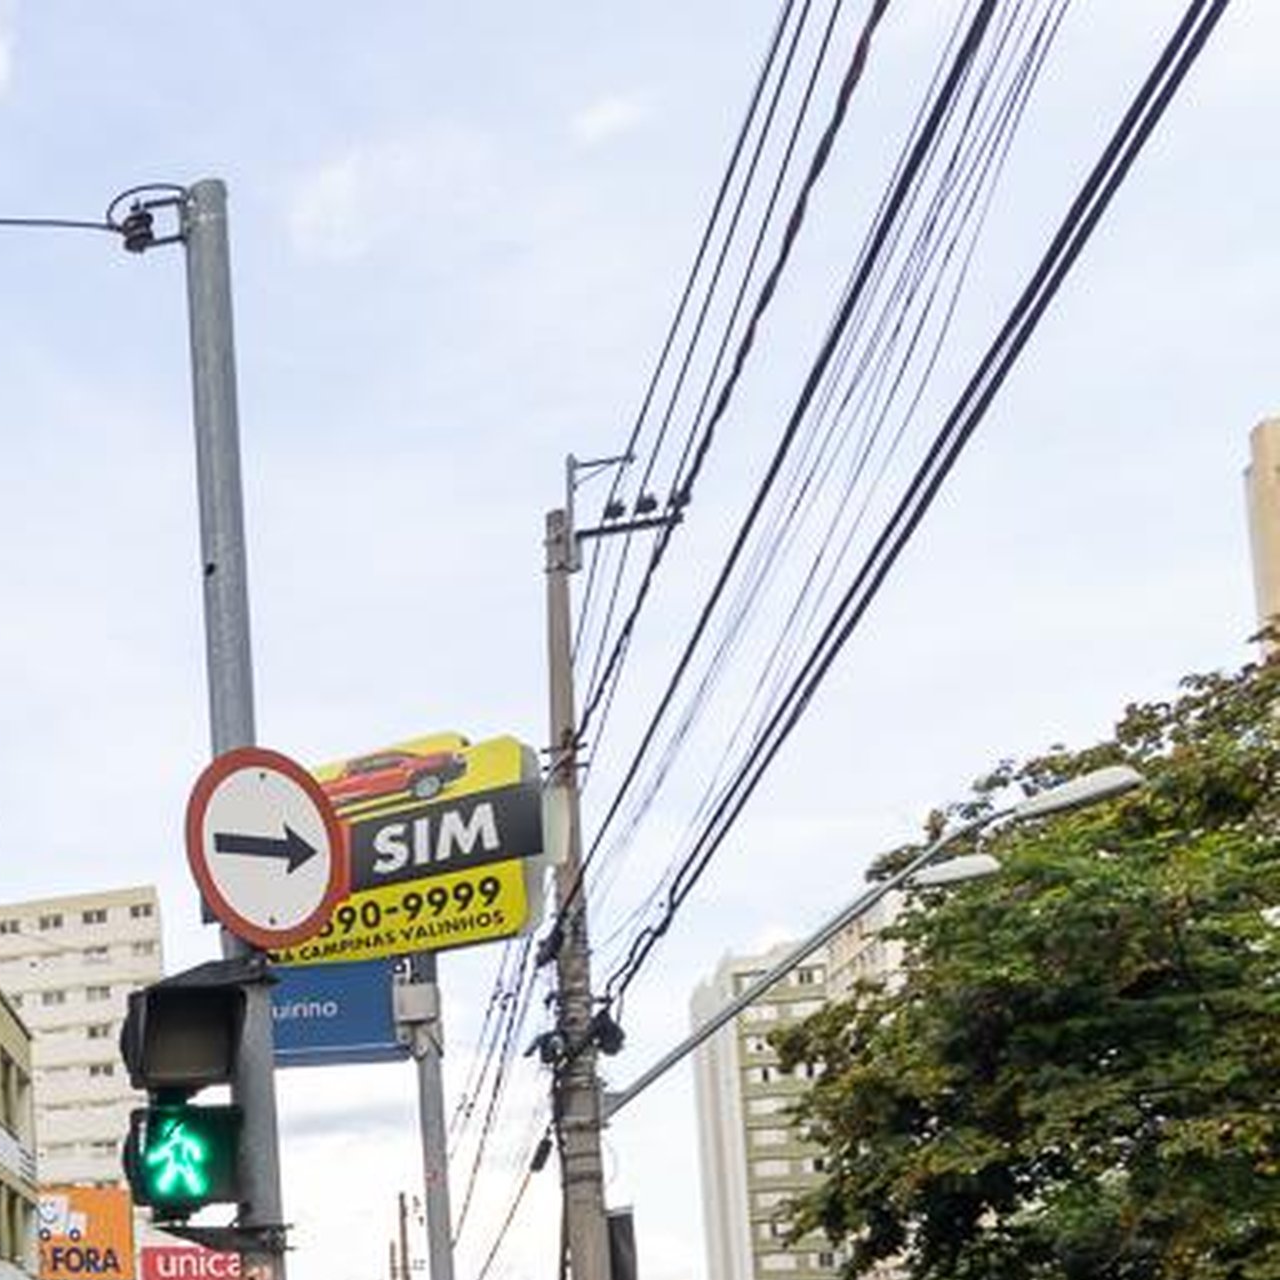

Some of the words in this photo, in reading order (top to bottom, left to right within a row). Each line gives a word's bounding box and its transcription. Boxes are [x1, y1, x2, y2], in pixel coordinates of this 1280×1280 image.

[372, 803, 500, 874] SIM
[299, 932, 396, 961] CAMPINAS
[398, 910, 505, 943] VALINHOS
[271, 1000, 338, 1019] uirino
[51, 1246, 122, 1274] FORA
